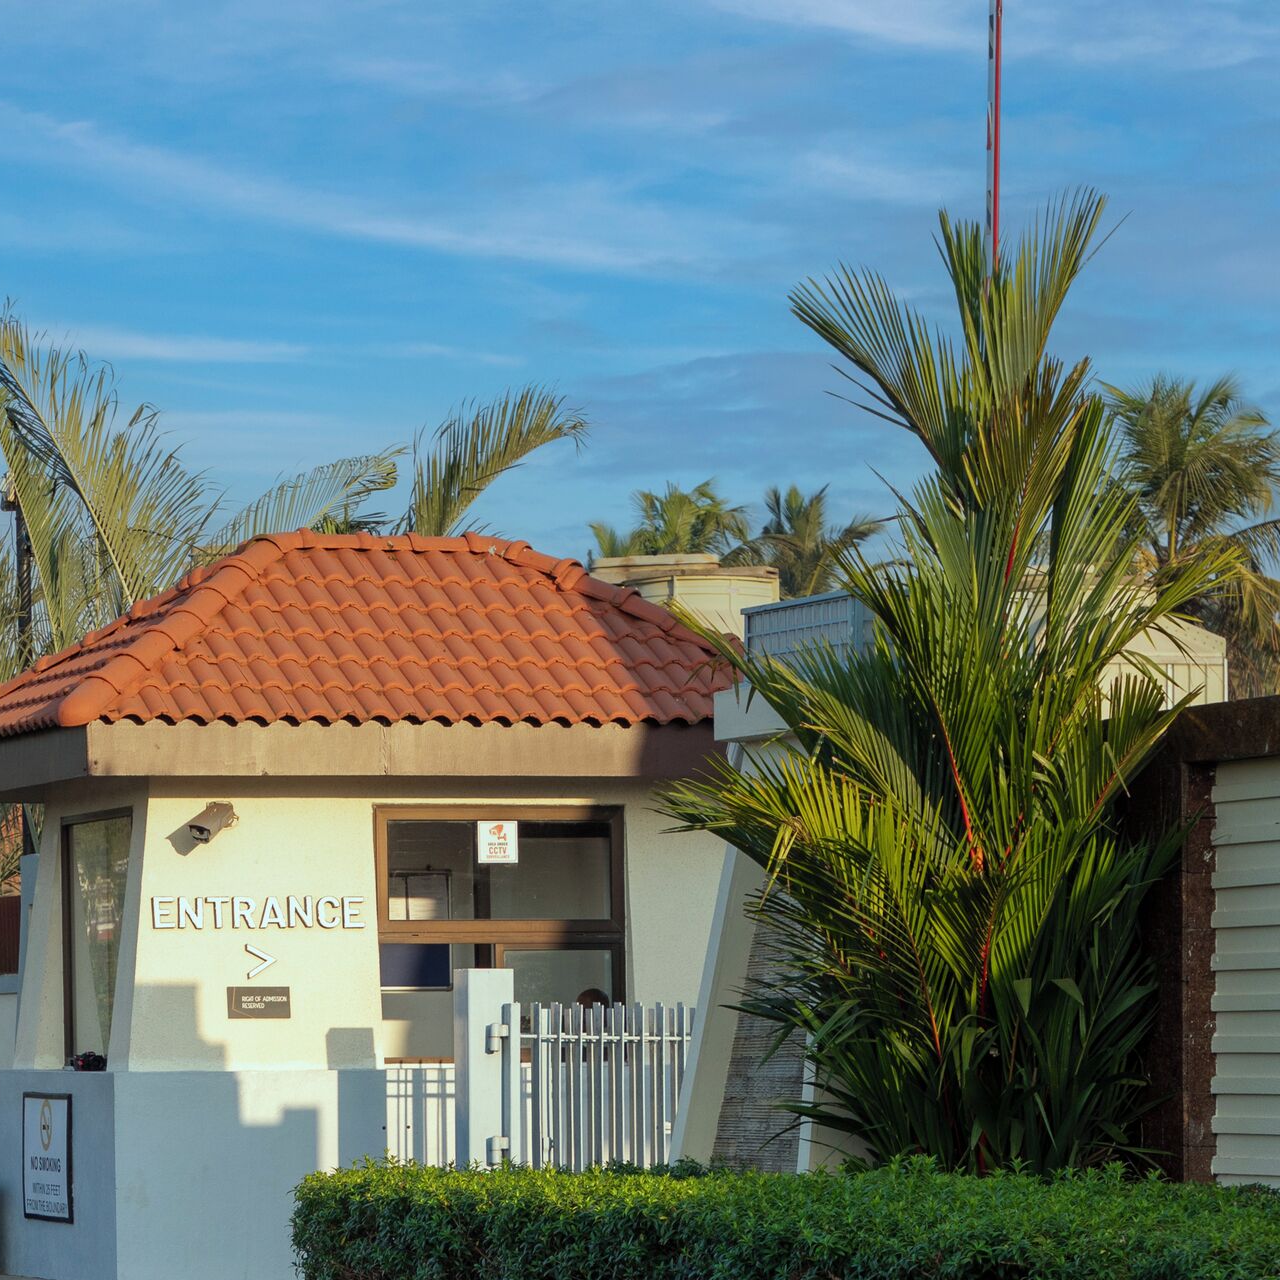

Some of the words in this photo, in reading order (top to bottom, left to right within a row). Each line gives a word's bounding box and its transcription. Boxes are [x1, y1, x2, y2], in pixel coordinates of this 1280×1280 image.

[488, 846, 507, 854] CCTV
[151, 895, 366, 929] ENTRANCE
[31, 1156, 38, 1170] NO
[39, 1157, 61, 1173] SMOKING
[51, 1183, 61, 1197] FEET
[27, 1198, 38, 1211] FROM
